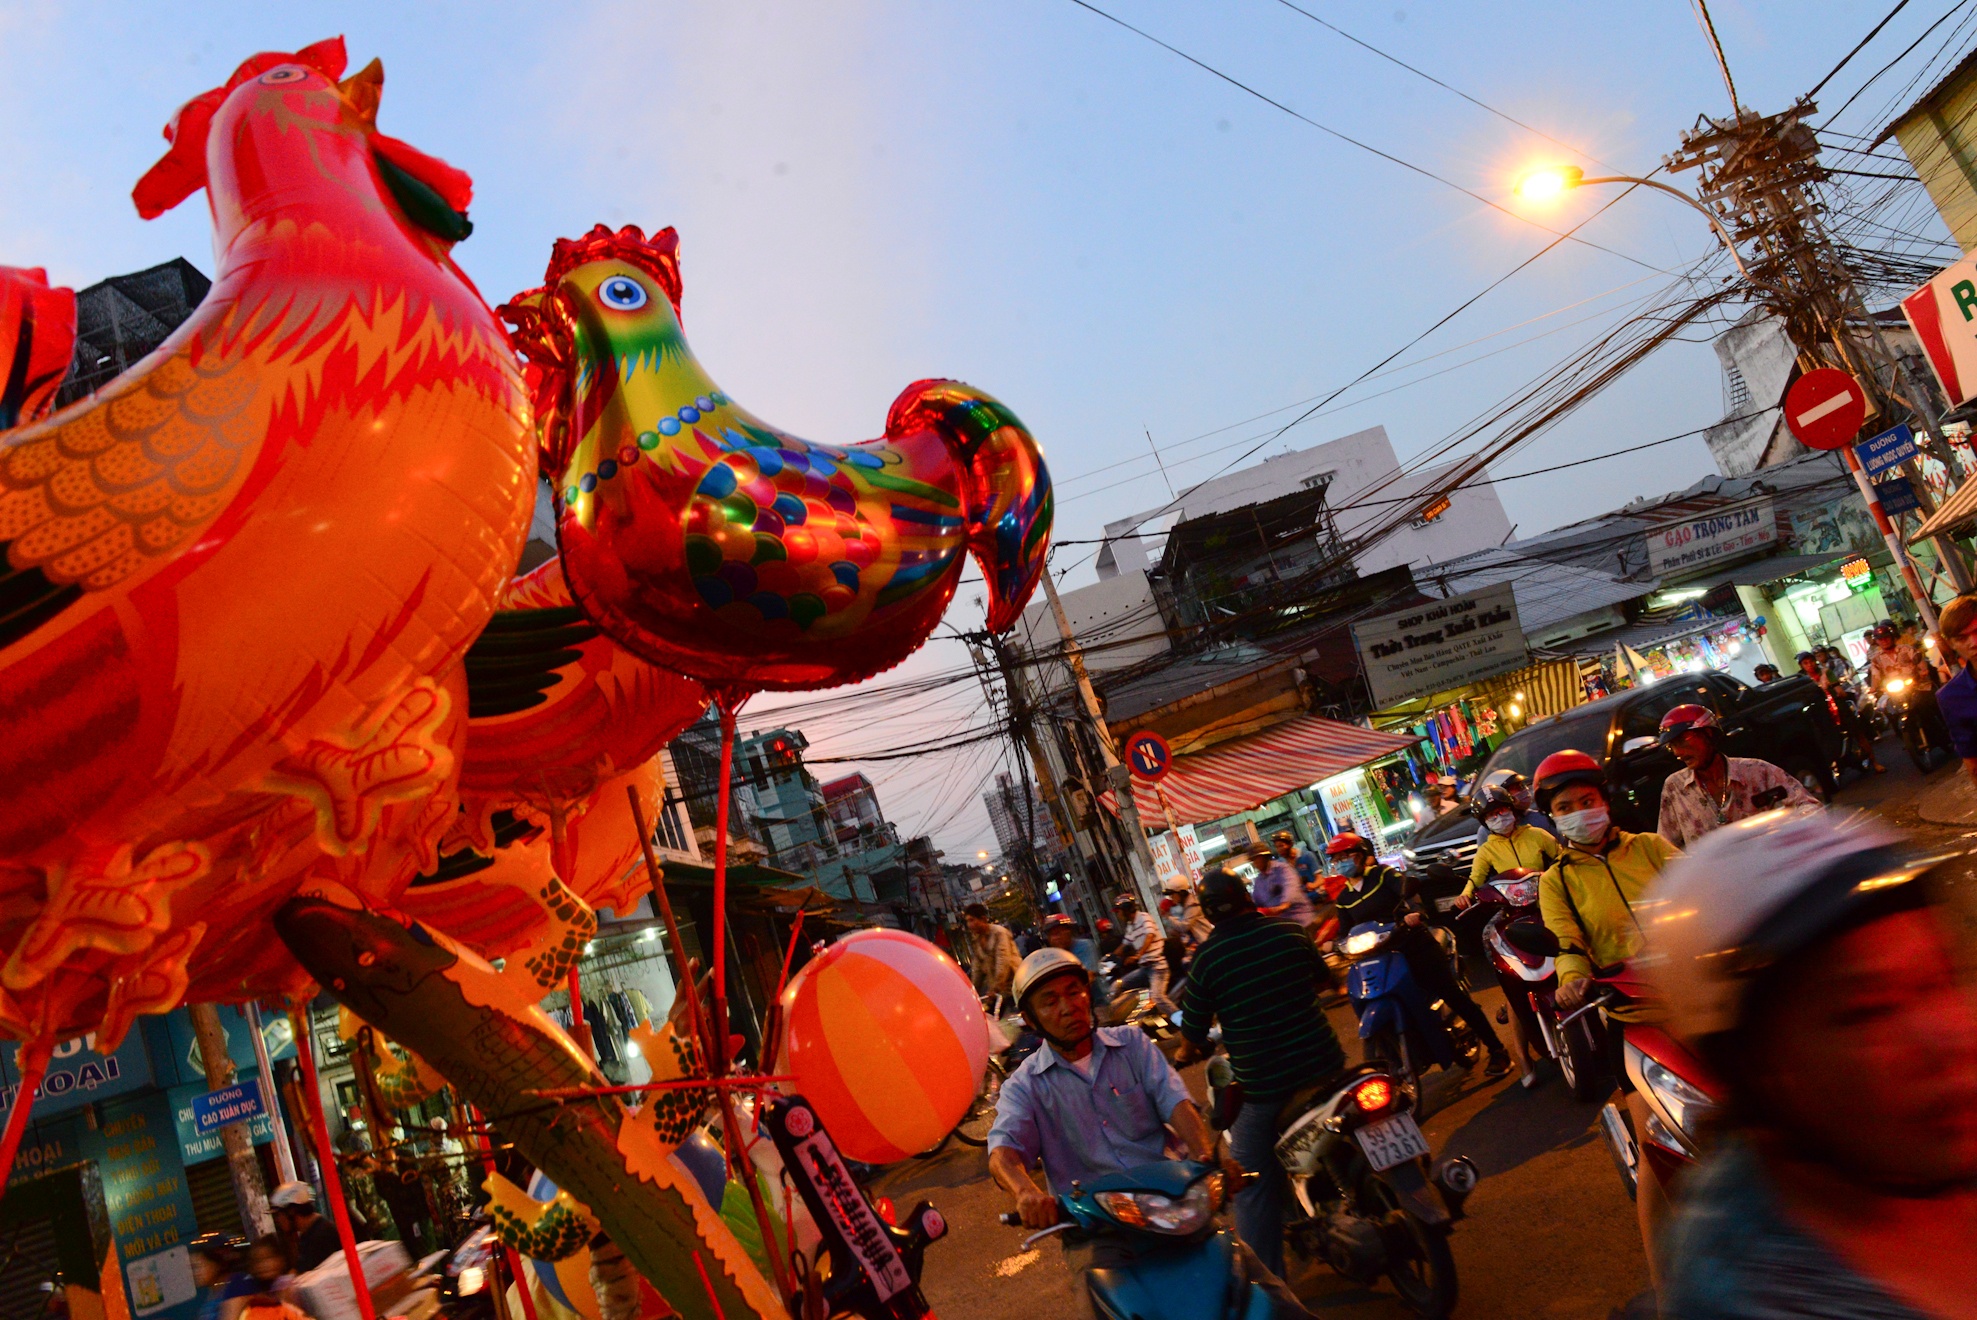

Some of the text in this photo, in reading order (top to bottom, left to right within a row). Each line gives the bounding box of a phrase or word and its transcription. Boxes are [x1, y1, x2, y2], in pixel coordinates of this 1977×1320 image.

[1869, 433, 1897, 452] ĐƯỜNG
[1882, 448, 1898, 464] NGỌC
[1897, 439, 1914, 459] QUYẾN
[1665, 507, 1760, 548] GẠO TRỌNG TÂM
[1370, 605, 1512, 660] Thời Trang Xuất Khẩu
[1398, 615, 1424, 630] SHOP
[1387, 659, 1410, 672] Chuyên
[1423, 652, 1436, 661] Bán
[1436, 648, 1452, 660] Hàng
[1472, 635, 1487, 647] Xuất
[1400, 668, 1414, 679] Việt
[1414, 664, 1428, 674] Nam
[1432, 654, 1466, 672] Campuchia
[1469, 648, 1484, 658] Thái
[1484, 645, 1497, 654] Lan
[1848, 640, 1868, 658] DV
[208, 1088, 243, 1106] ĐƯỜNG
[201, 1113, 218, 1126] CAO
[218, 1103, 240, 1121] XUÂN
[240, 1099, 257, 1116] DỤC
[184, 1144, 203, 1157] THU
[203, 1136, 222, 1152] MUA
[116, 1203, 177, 1236] ĐIỆN THOẠI
[123, 1236, 146, 1259] MỚI
[148, 1230, 163, 1250] VÀ
